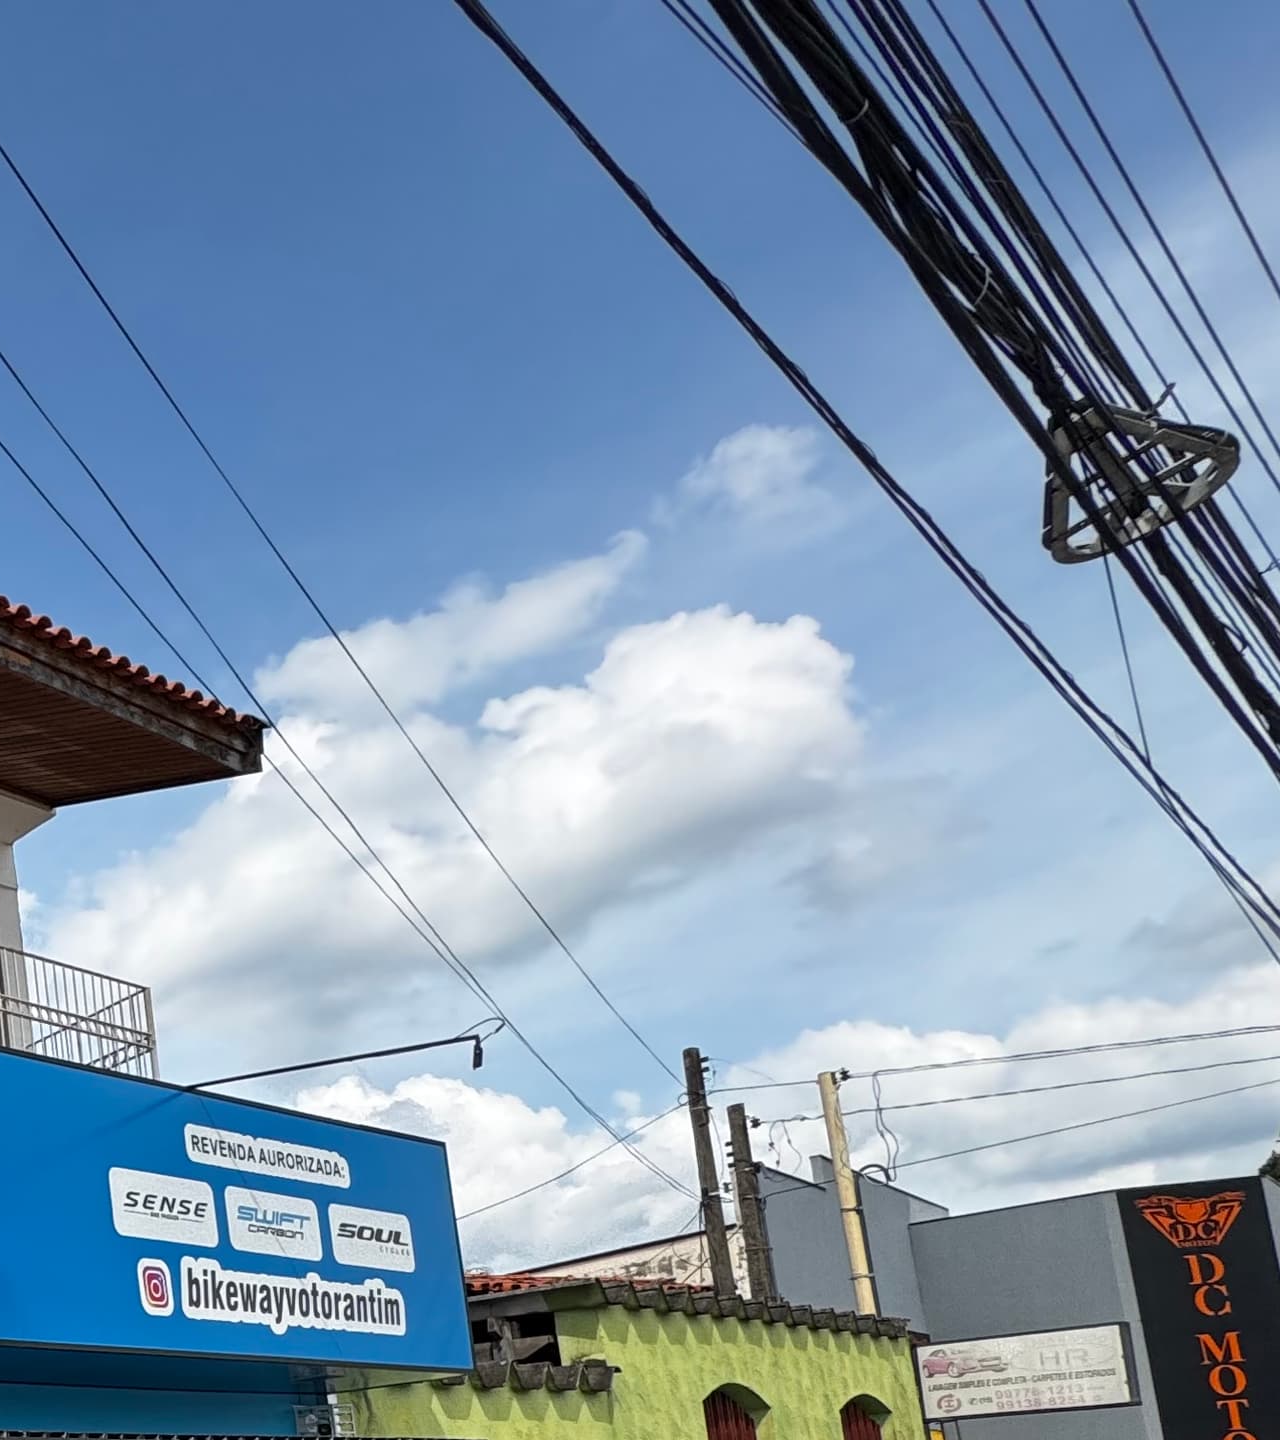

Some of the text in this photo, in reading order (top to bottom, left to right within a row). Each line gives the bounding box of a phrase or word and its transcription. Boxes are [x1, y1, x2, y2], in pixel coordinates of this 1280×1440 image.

[190, 1133, 347, 1181] REVENDA AURORIZADA:
[123, 1190, 209, 1219] SENSE
[236, 1204, 312, 1230] SWIFT
[247, 1223, 305, 1242] CARBON
[336, 1222, 409, 1247] SOUL
[186, 1266, 402, 1325] bikewayvotorantim
[1182, 1252, 1233, 1317] DC
